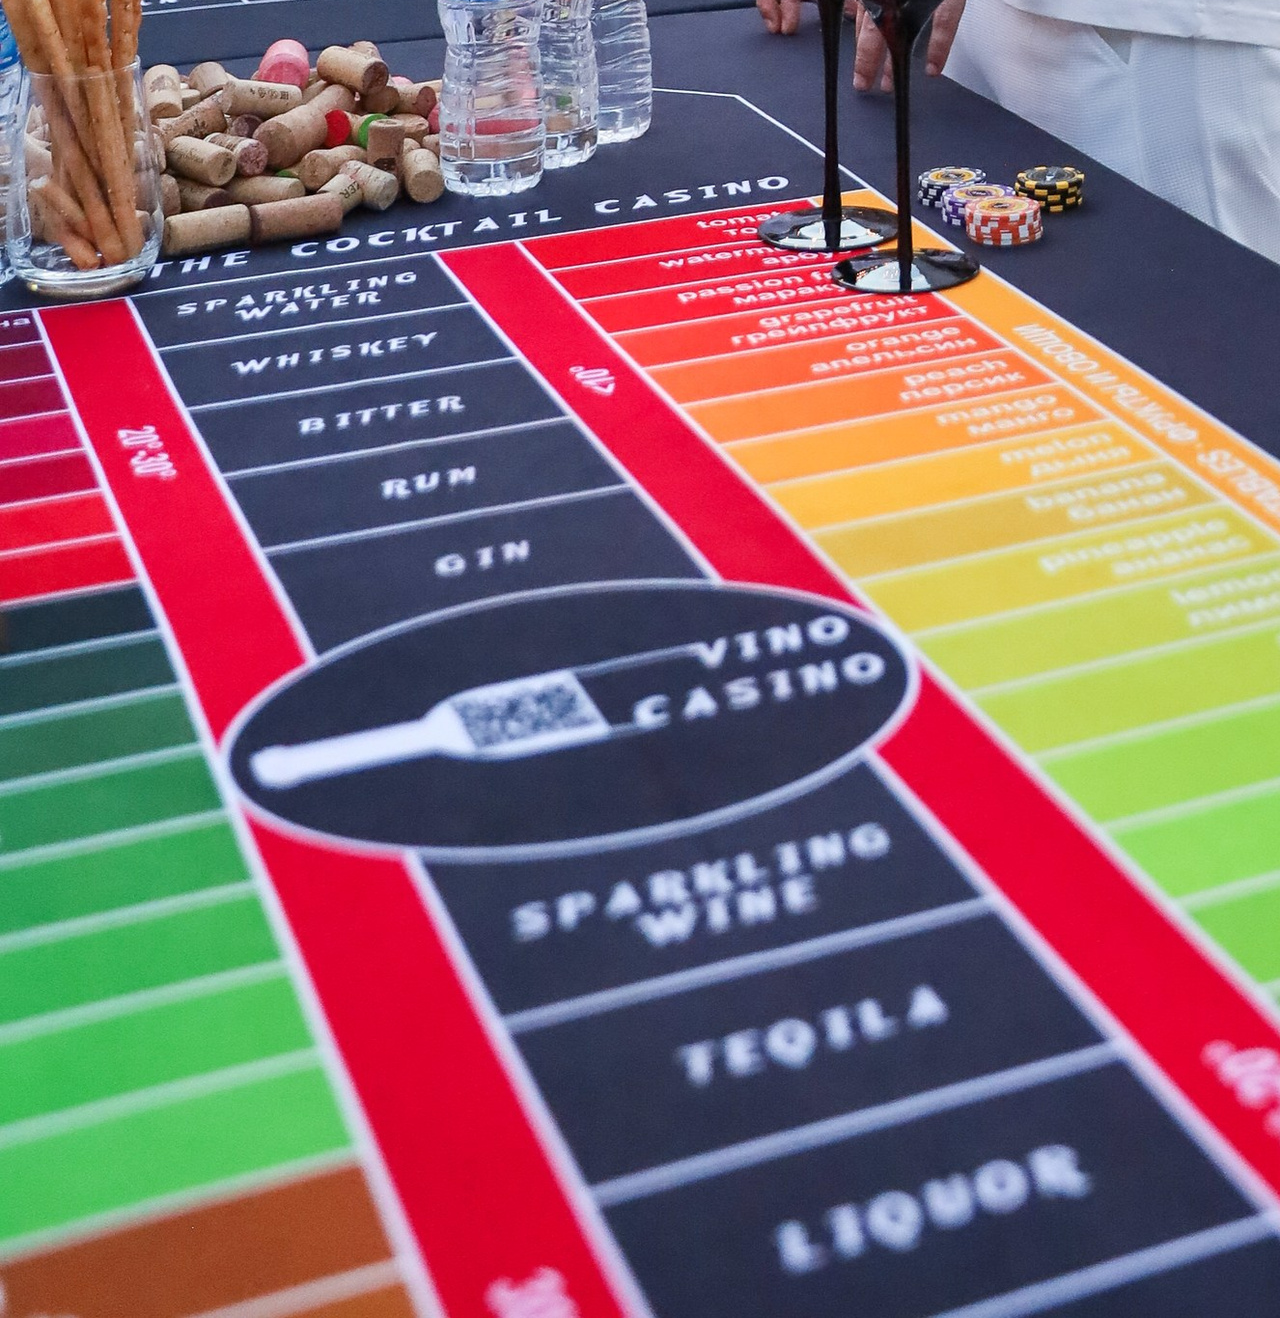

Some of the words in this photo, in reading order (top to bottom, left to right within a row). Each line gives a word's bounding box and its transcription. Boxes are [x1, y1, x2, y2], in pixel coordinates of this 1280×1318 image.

[148, 250, 251, 279] THE
[290, 208, 562, 257] COCKTAIL
[594, 175, 790, 214] CASINO
[696, 210, 784, 229] tomat
[658, 245, 789, 269] waterm
[177, 272, 417, 315] SPARKLING
[235, 290, 381, 321] WATER
[677, 273, 804, 304] passion
[732, 281, 847, 305] мараку
[730, 304, 928, 346] грейпфрукт
[758, 294, 918, 329] grapefruit
[231, 331, 437, 376] WHISKEY
[809, 336, 978, 374] апельсин
[845, 326, 961, 353] orange
[1012, 322, 1099, 372] ОВОЩИ
[900, 370, 1026, 403] персик
[904, 358, 1008, 387] peach
[298, 395, 466, 436] BITTER
[935, 393, 1057, 425] mango
[967, 408, 1075, 436] манго
[1000, 432, 1112, 463] melon
[1030, 446, 1131, 477] дыня
[380, 466, 477, 499] RUM
[1025, 472, 1166, 511] banana
[1067, 487, 1187, 521] банан
[434, 540, 530, 577] GIN
[1039, 518, 1229, 575] pineapple
[1112, 535, 1250, 577] ананас
[698, 614, 850, 669] VINO
[633, 651, 886, 730] CASINO
[512, 821, 892, 944] SPARKLING
[634, 873, 818, 948] WINE
[677, 984, 949, 1087] TEQILA
[775, 1142, 1094, 1276] LIQUOR
